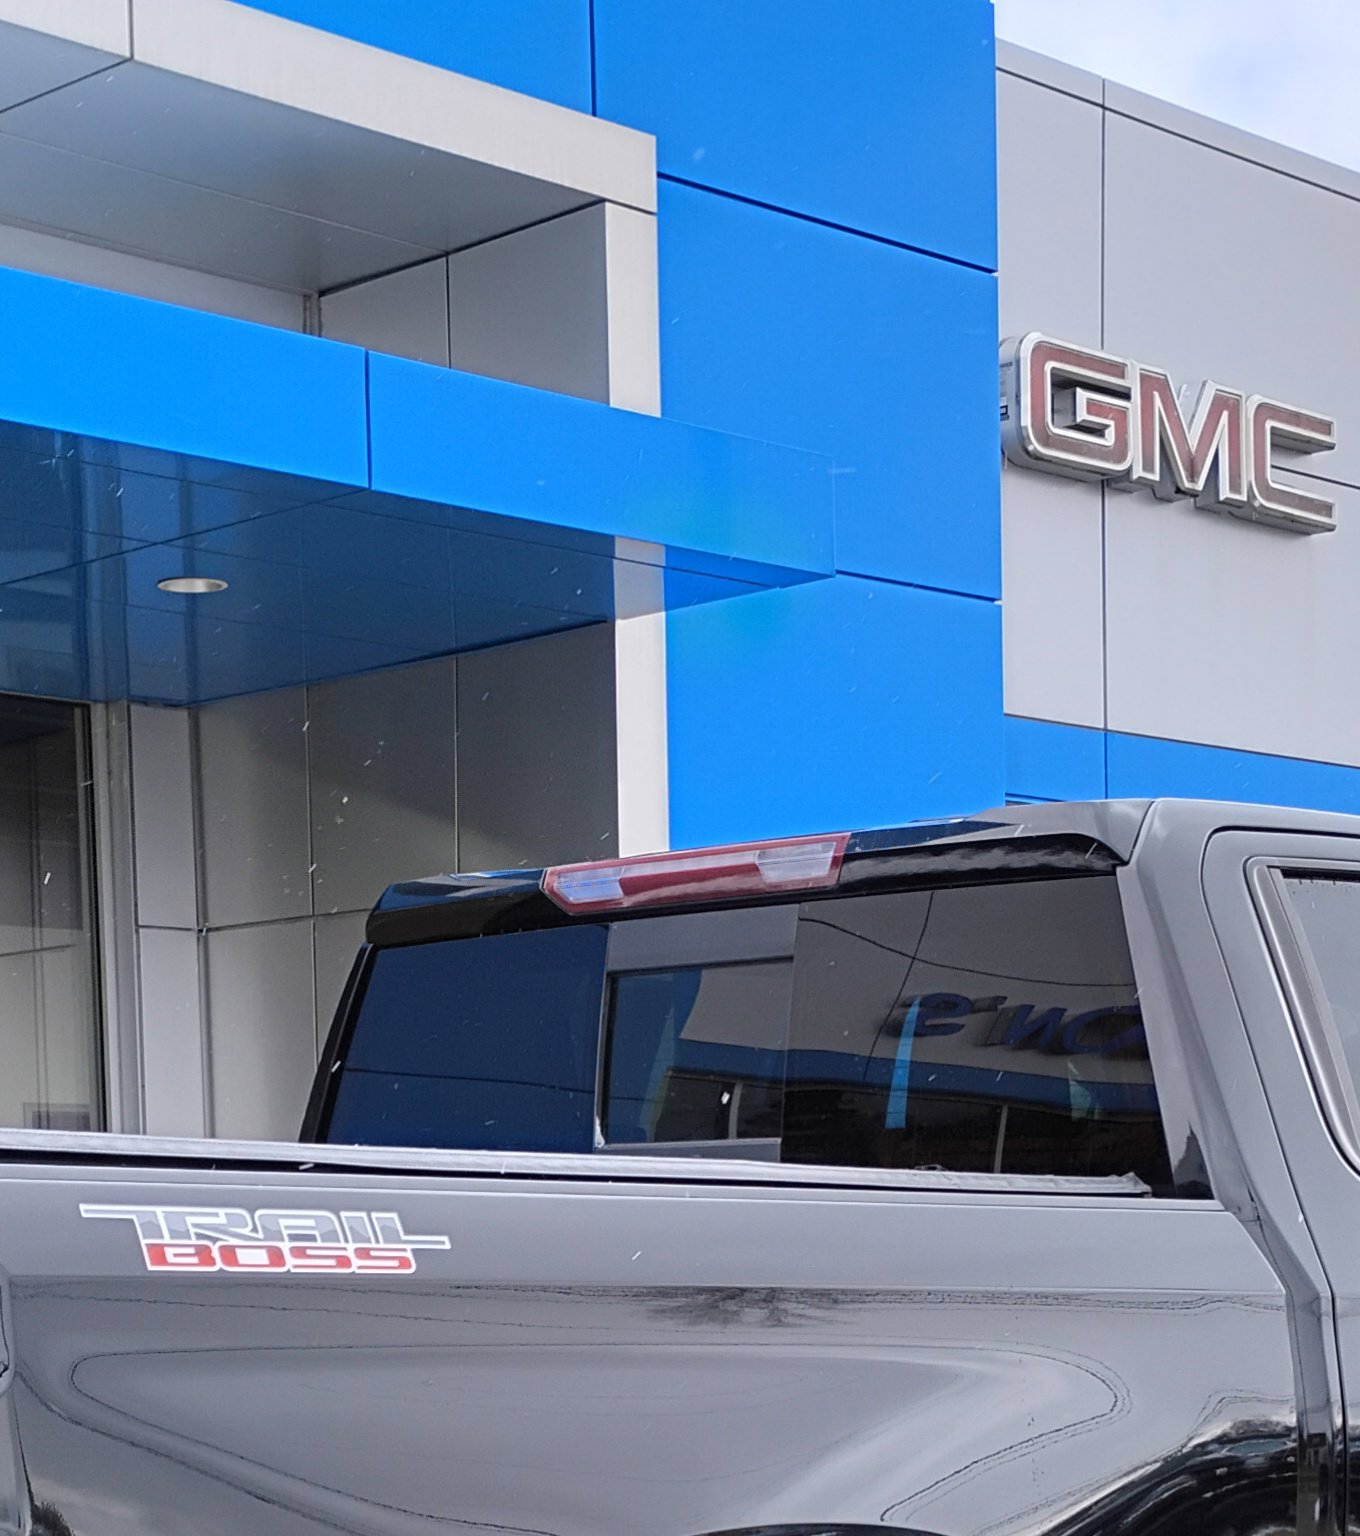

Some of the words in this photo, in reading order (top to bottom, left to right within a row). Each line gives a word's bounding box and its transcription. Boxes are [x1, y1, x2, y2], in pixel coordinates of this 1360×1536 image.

[1019, 331, 1337, 532] GMC
[79, 1203, 451, 1248] TRAIL
[144, 1239, 417, 1274] BOSS
